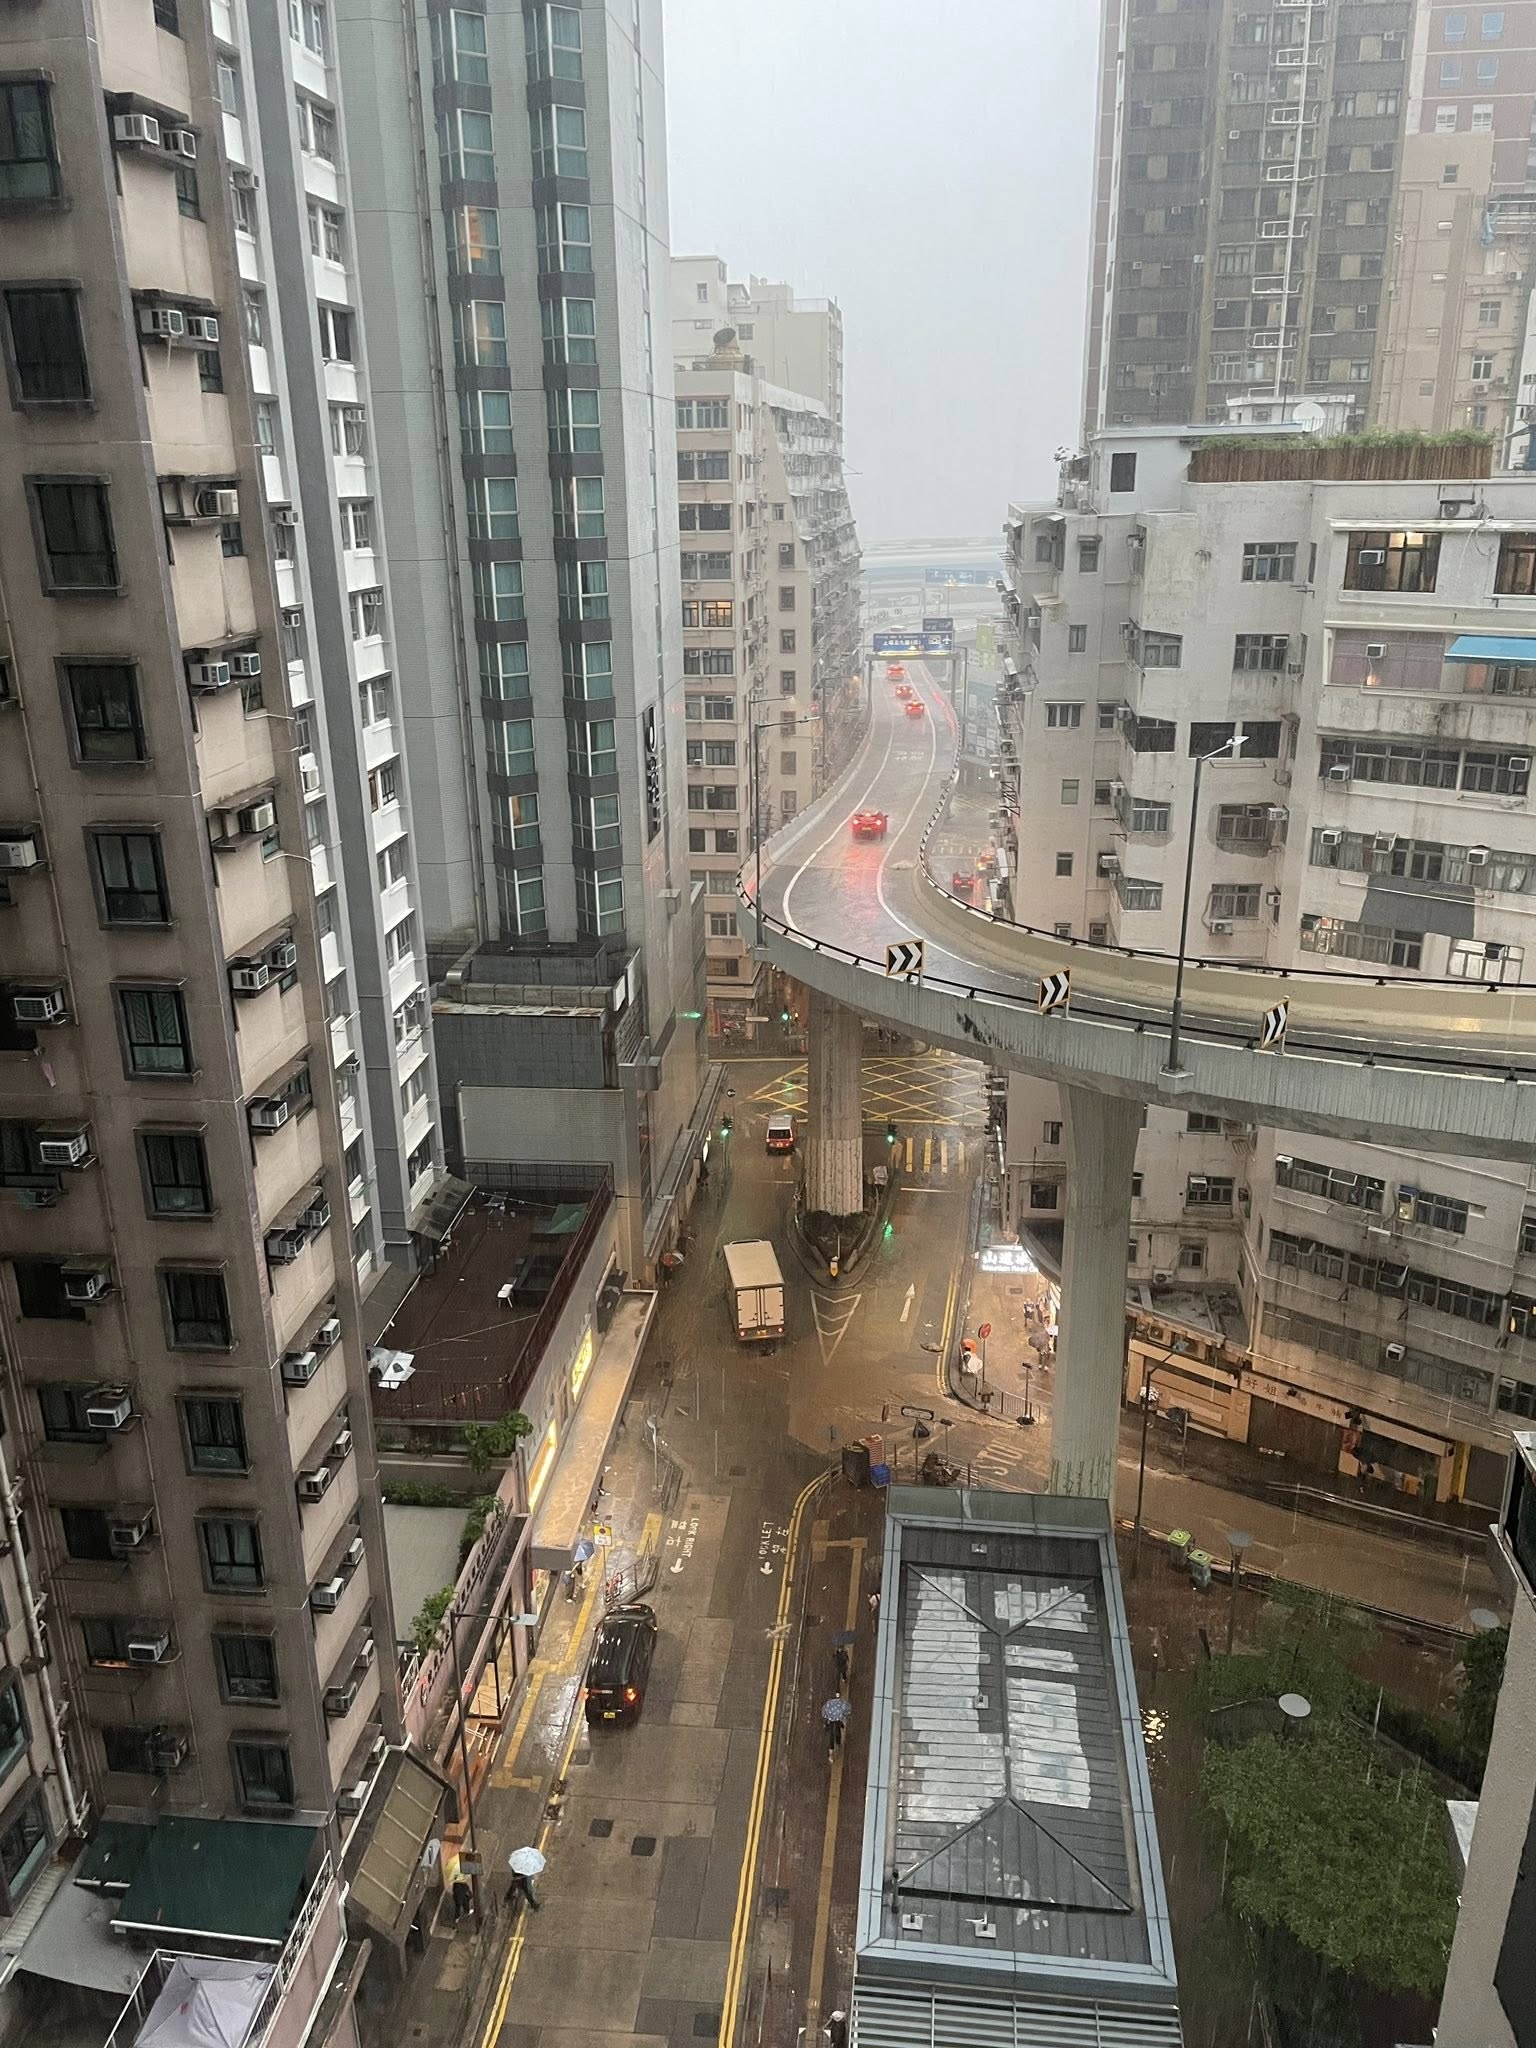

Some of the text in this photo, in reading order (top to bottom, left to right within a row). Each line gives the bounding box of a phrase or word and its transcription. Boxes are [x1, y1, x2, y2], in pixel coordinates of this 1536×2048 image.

[982, 1250, 1034, 1265] 山道冰
[681, 1517, 700, 1558] LOOK RIGHT
[761, 1521, 774, 1539] LET
